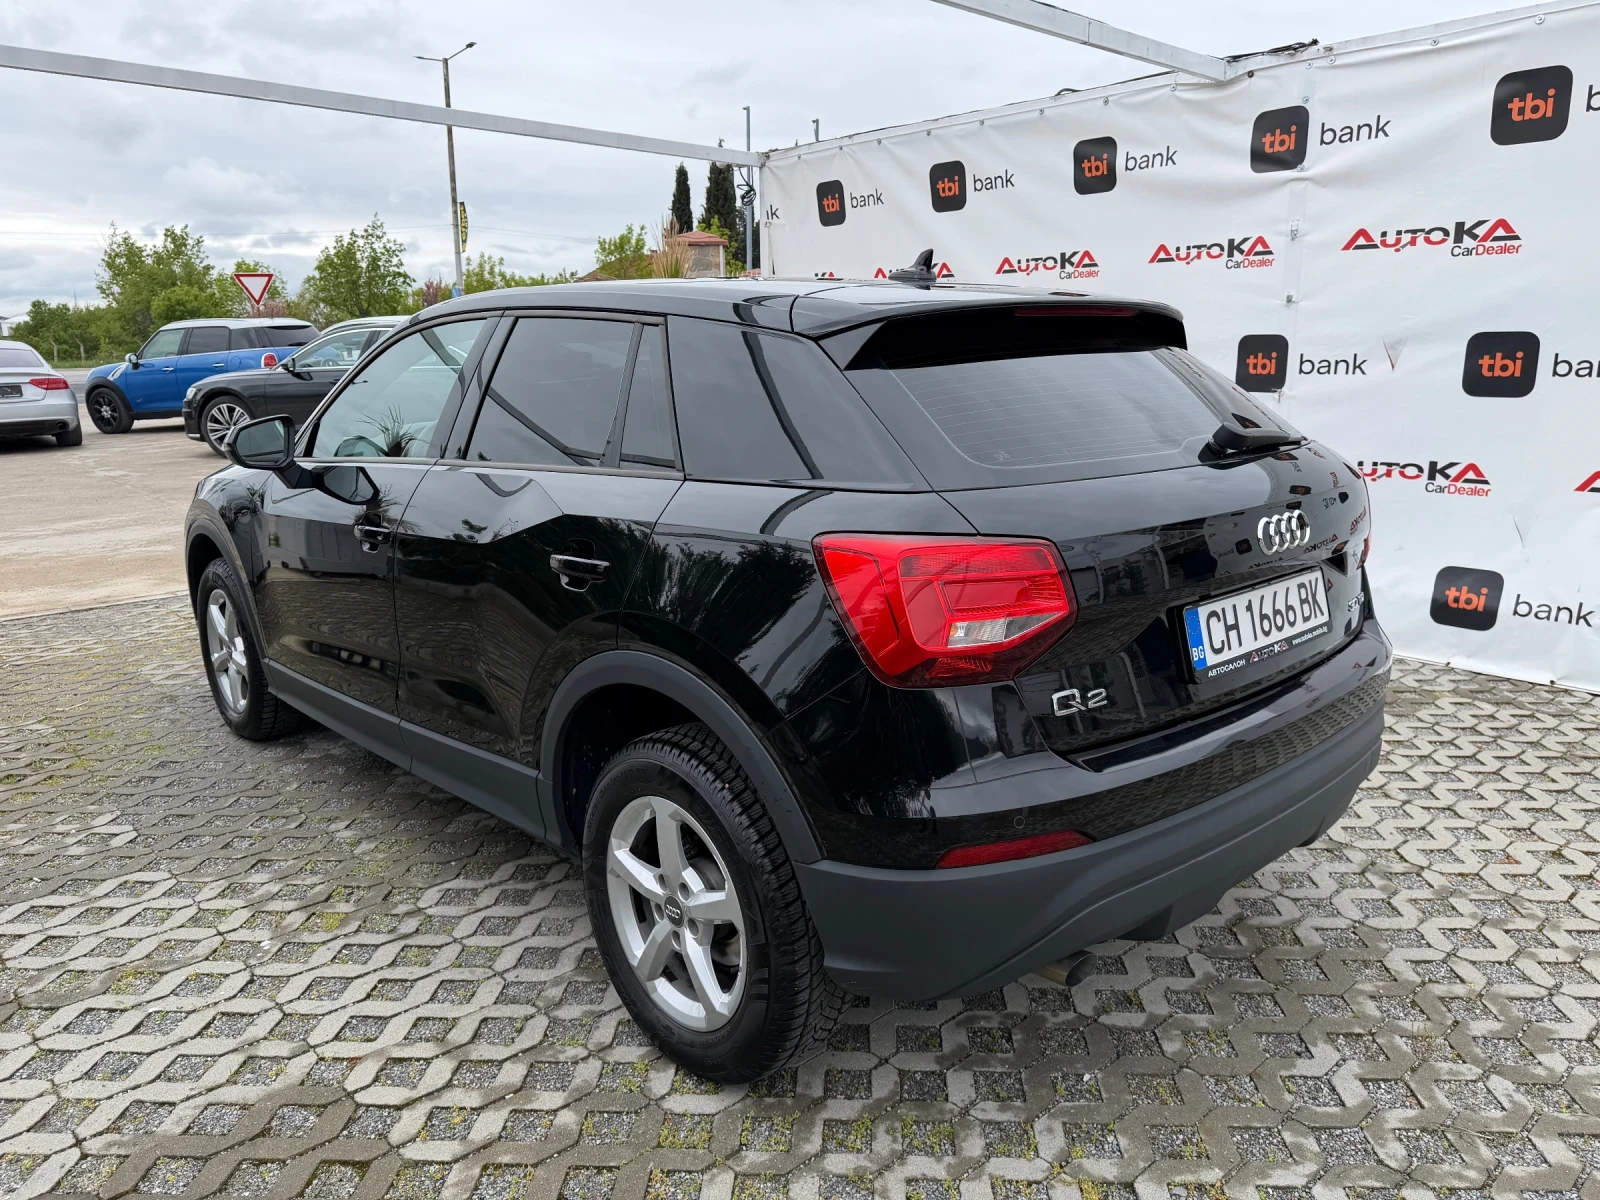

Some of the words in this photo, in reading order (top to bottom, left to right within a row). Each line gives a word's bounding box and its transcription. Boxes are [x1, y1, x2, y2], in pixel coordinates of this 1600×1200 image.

[1507, 88, 1556, 122] tbi
[1262, 125, 1297, 154] tbi
[1319, 115, 1391, 146] bank
[1081, 153, 1108, 178] tbi
[1124, 146, 1177, 172] bank
[936, 175, 959, 197] tbi
[973, 169, 1015, 192] bank
[822, 193, 840, 213] tbi
[850, 188, 885, 209] bank
[1451, 243, 1522, 257] CarDealer
[1059, 269, 1100, 280] CarDealer
[1225, 257, 1275, 270] CarDealer
[1246, 352, 1277, 375] tbi
[1298, 353, 1367, 376] bank
[1478, 351, 1524, 378] tbi
[1551, 352, 1600, 378] ba
[1425, 482, 1492, 497] CarDealer
[1206, 604, 1242, 655] CH
[1246, 586, 1297, 642] 1666
[1297, 577, 1325, 623] BK
[1445, 586, 1489, 612] tbi
[1512, 593, 1595, 627] bank
[1192, 646, 1205, 661] BG
[1208, 659, 1246, 677] АВТОСАЛОН
[1051, 688, 1108, 717] Q2
